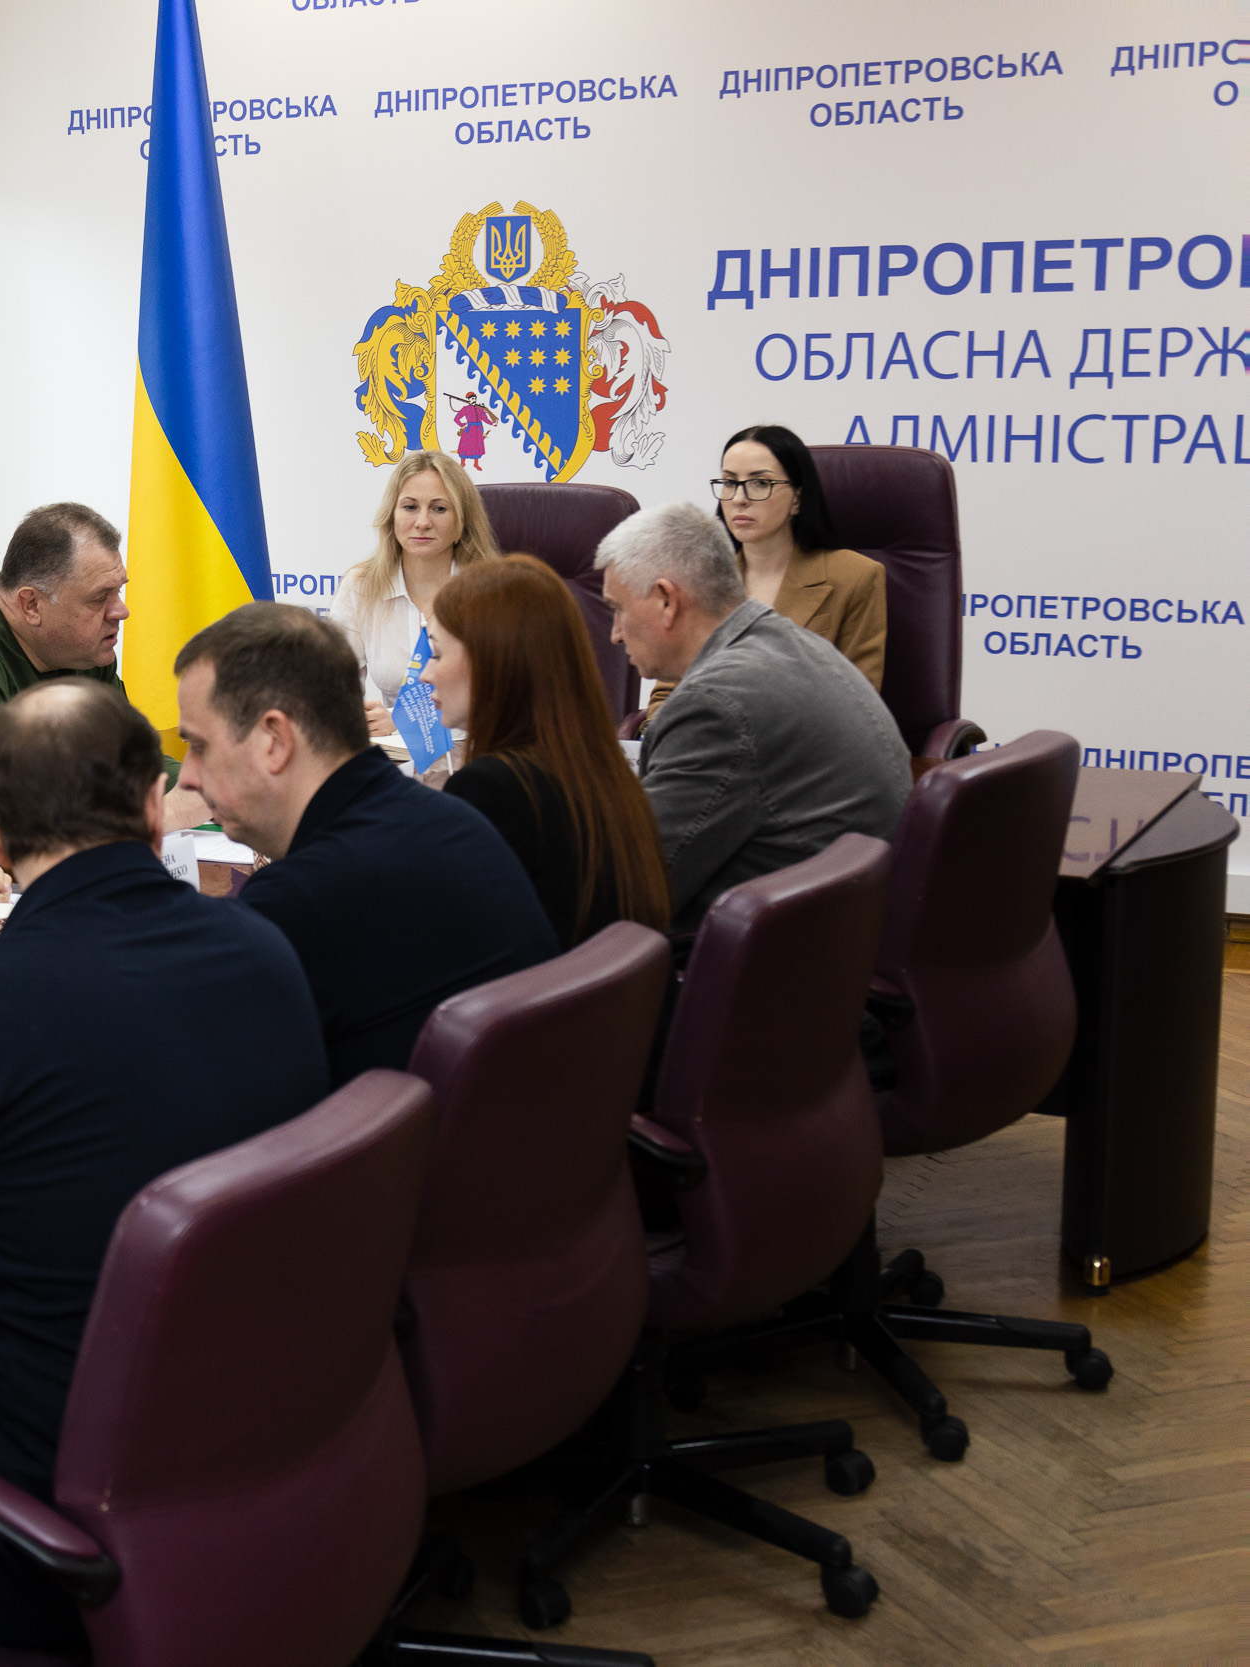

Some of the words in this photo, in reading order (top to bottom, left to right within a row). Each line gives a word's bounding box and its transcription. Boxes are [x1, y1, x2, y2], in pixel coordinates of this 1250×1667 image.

[375, 75, 678, 120] ДНІПРОПЕТРОВСЬКА
[720, 51, 1063, 100] ДНІПРОПЕТРОВСЬКА
[455, 117, 591, 145] ОБЛАСТЬ
[810, 97, 964, 127] ОБЛАСТЬ
[707, 234, 1250, 311] ДНІПРОПЕТРО
[755, 329, 1051, 382] ОБЛАСНА
[984, 630, 1143, 660] ОБЛАСТЬ
